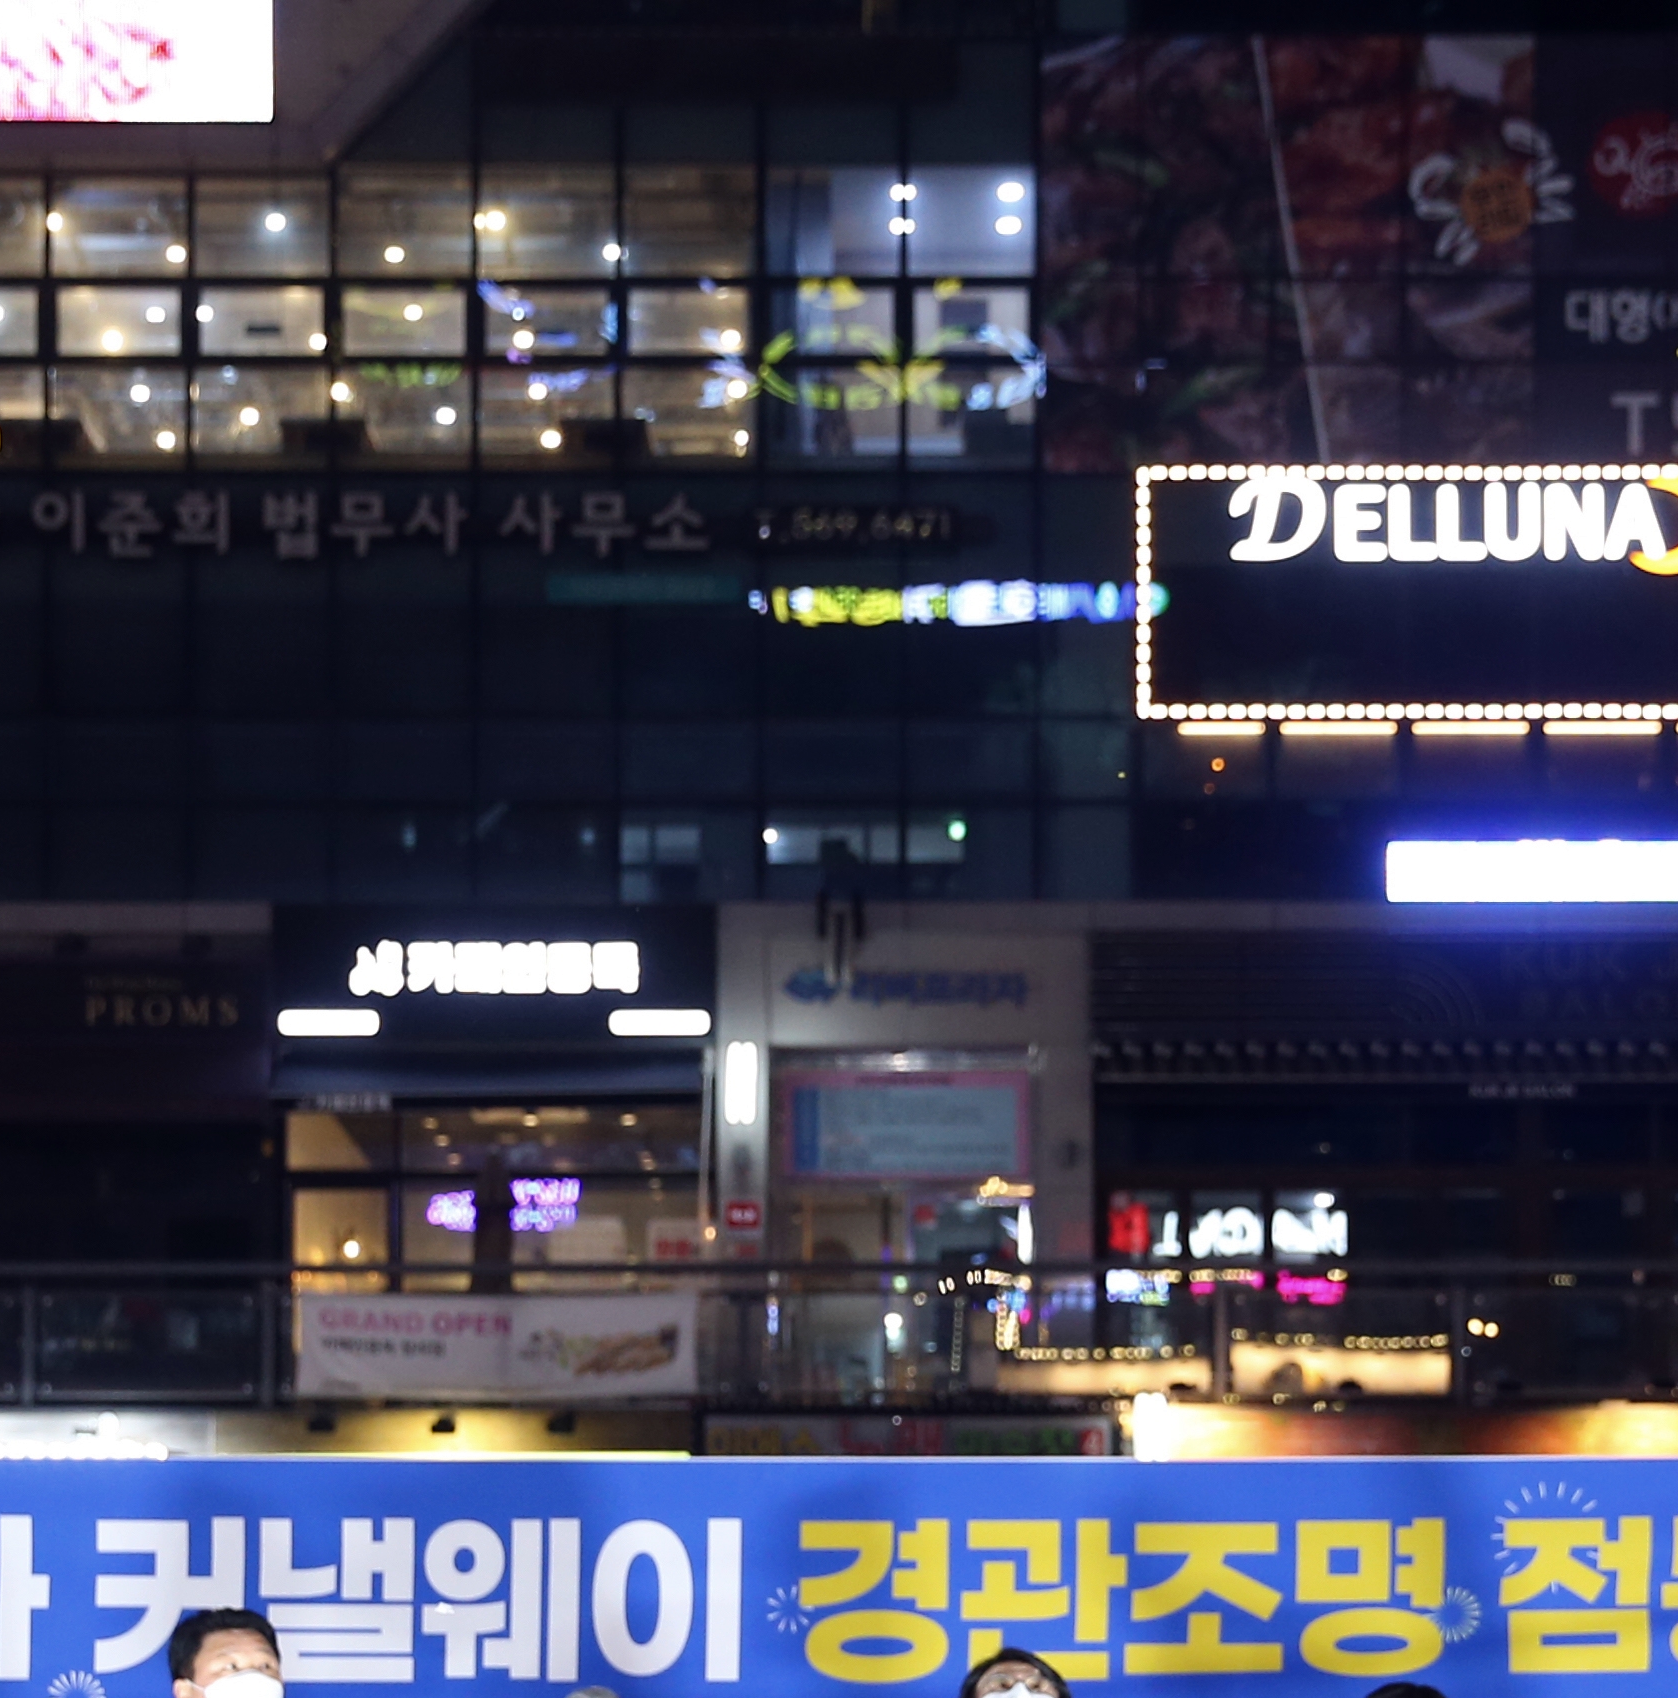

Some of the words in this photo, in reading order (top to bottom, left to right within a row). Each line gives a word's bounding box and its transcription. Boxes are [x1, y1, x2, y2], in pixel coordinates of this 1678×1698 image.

[29, 487, 233, 560] 이준희
[262, 487, 465, 561] 법무사
[499, 488, 711, 558] 사무소
[1228, 477, 1666, 564] DELLUNA
[85, 994, 239, 1027] PROMS
[319, 1307, 425, 1334] GRAND
[433, 1309, 512, 1336] OPEN
[93, 1512, 743, 1683] 커낼웨이
[798, 1514, 1447, 1683] 경관조명
